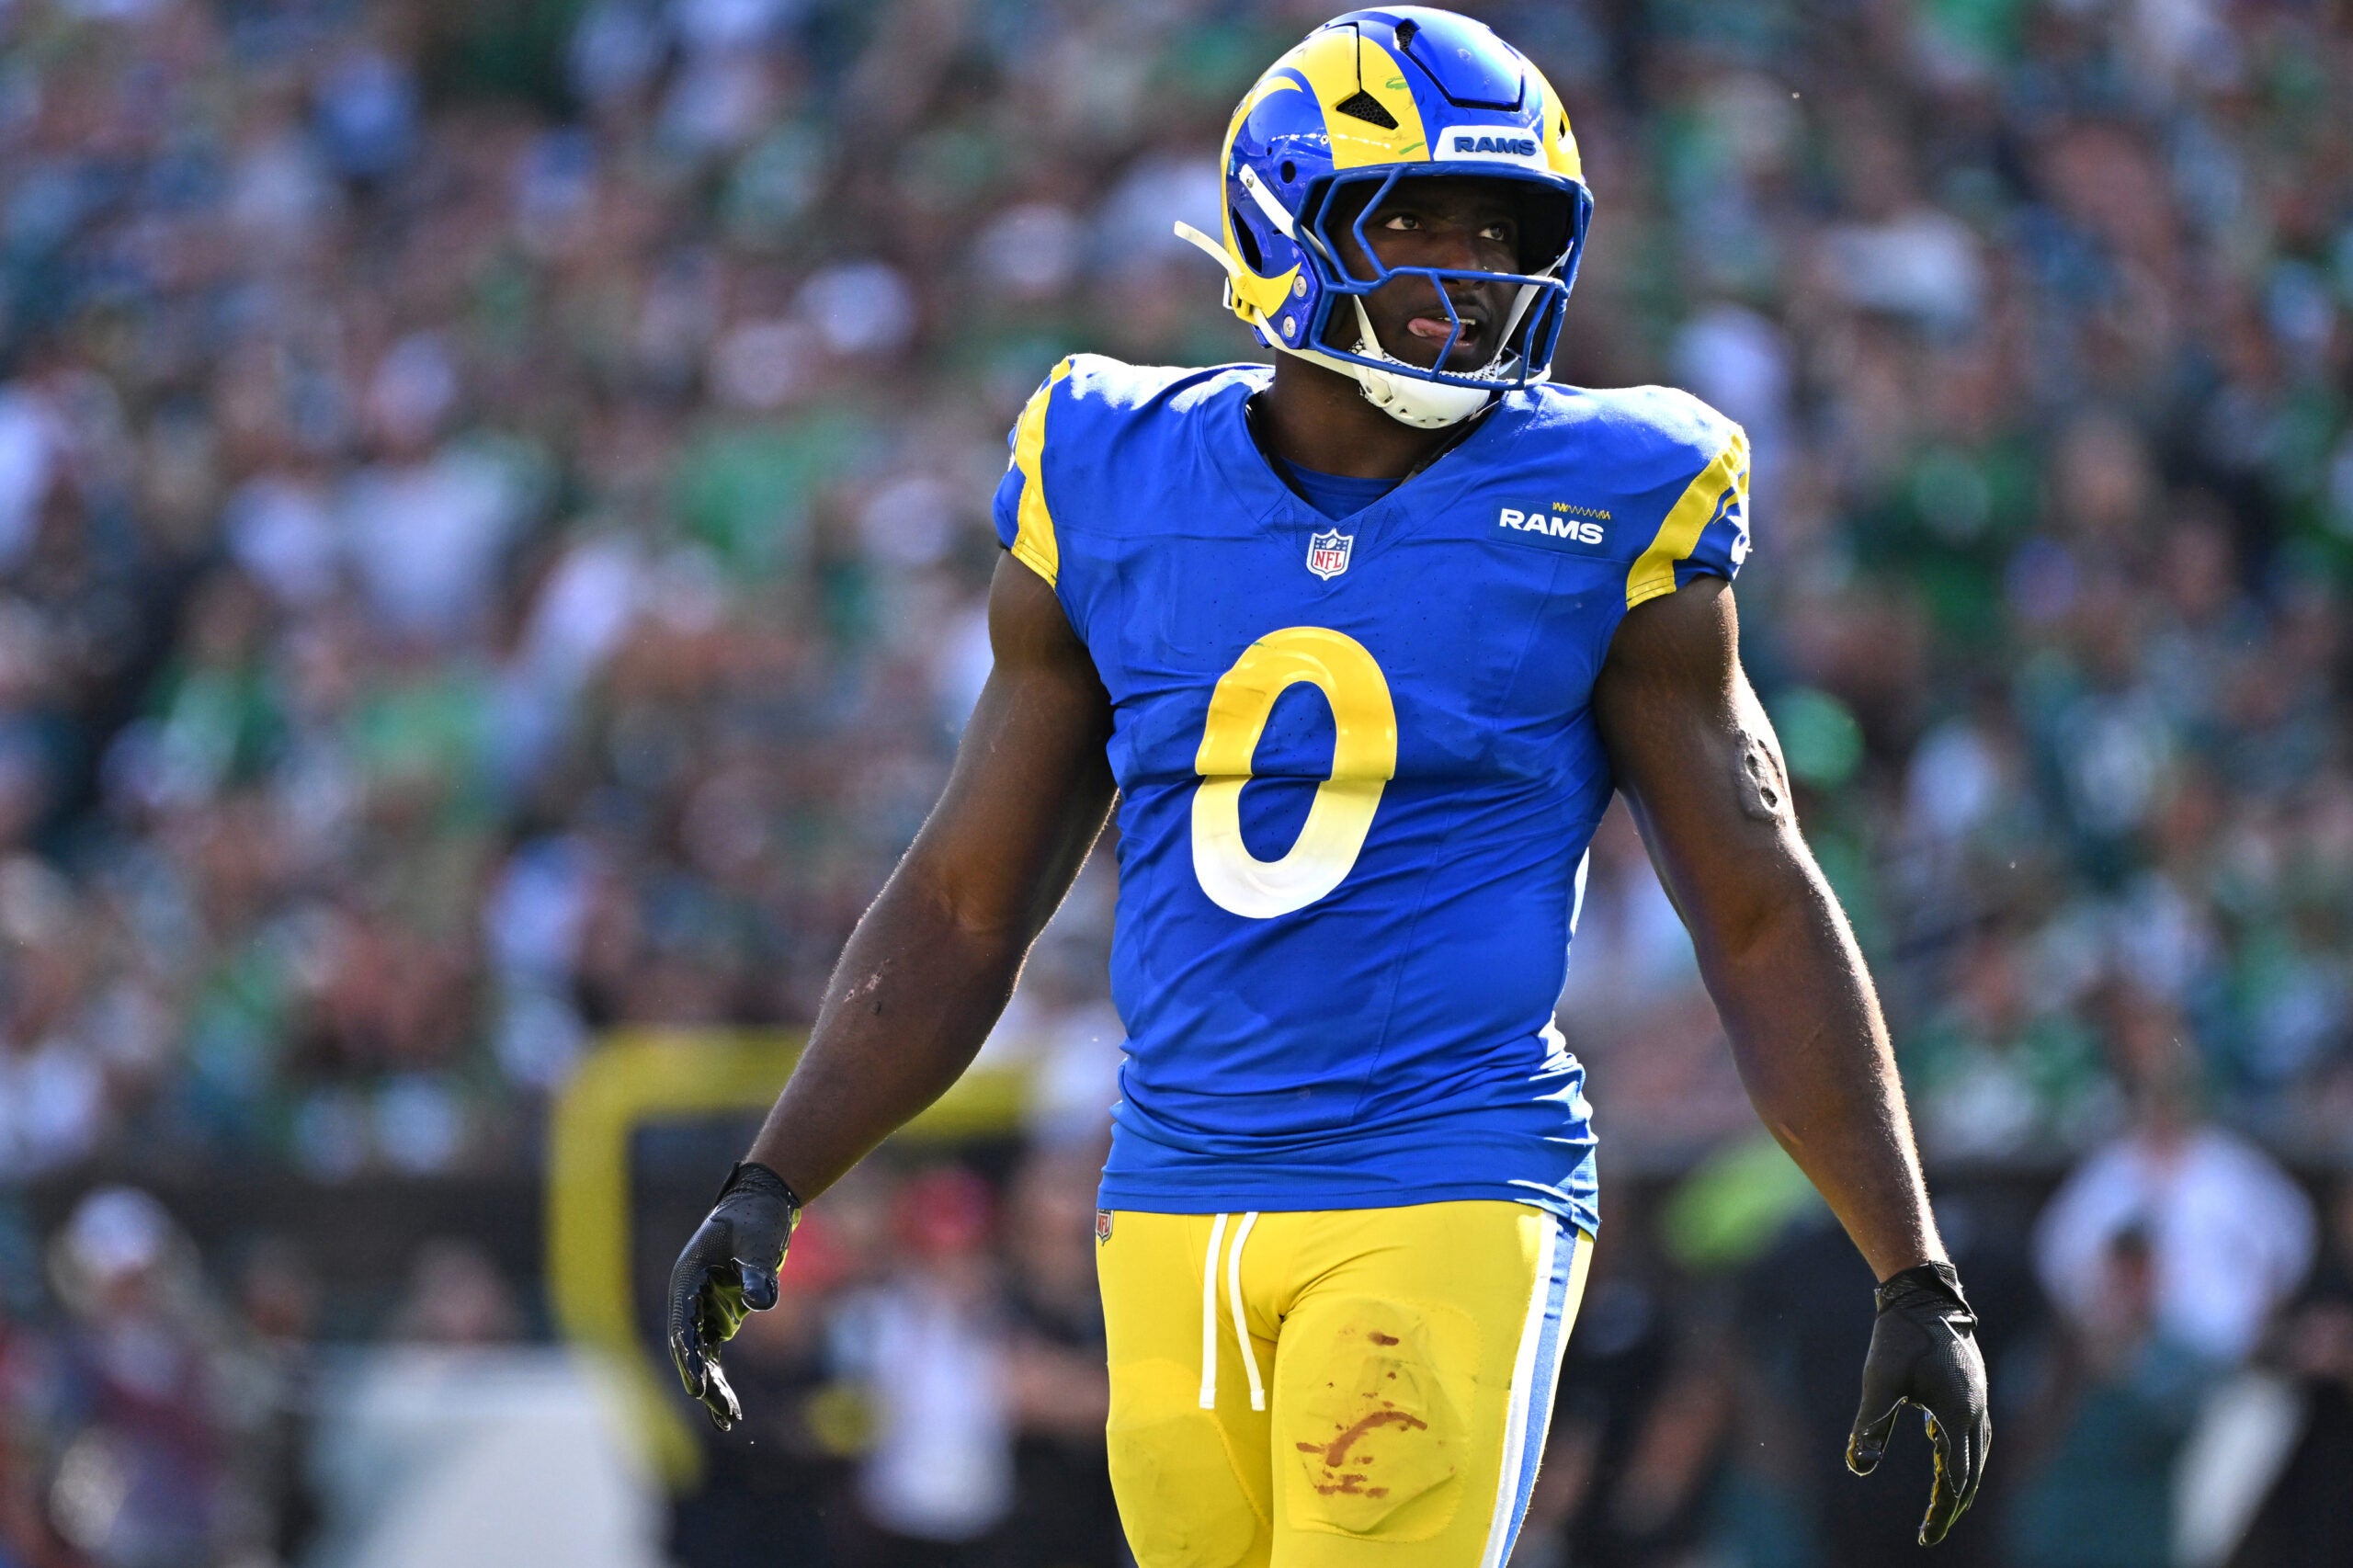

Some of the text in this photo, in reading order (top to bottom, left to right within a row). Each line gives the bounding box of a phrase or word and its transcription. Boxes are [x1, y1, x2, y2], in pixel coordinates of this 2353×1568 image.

[1453, 136, 1537, 156] RAMS
[1499, 507, 1604, 545] RAMS
[1313, 551, 1343, 571] NFL
[1191, 626, 1398, 919] 0
